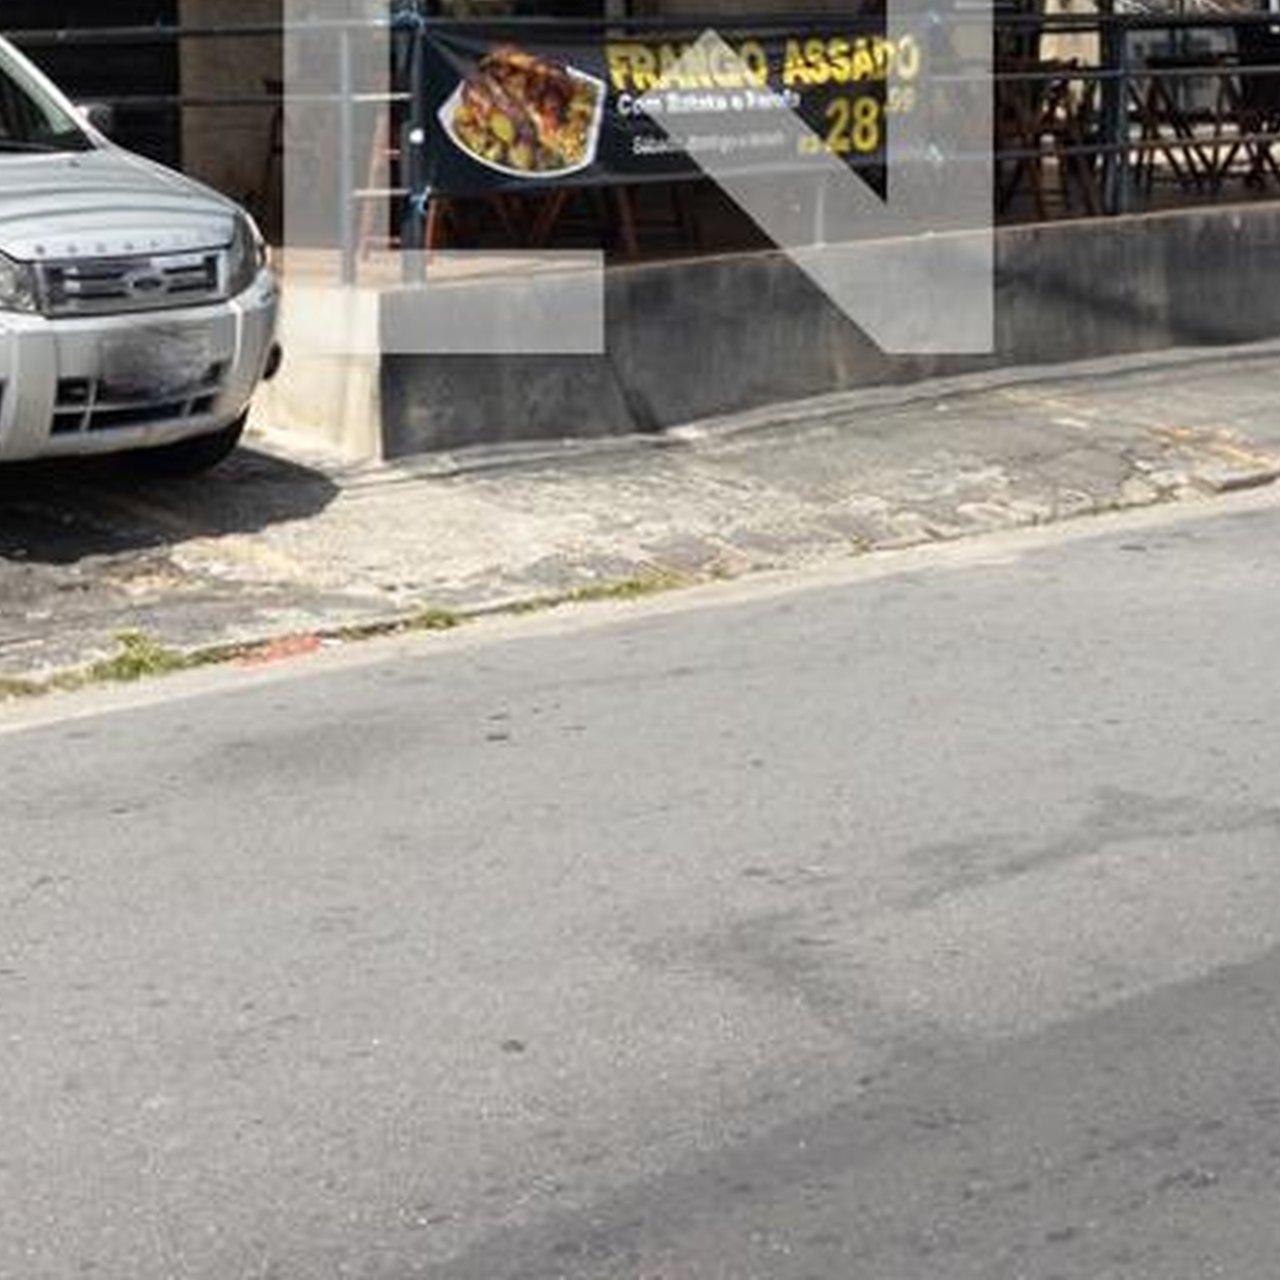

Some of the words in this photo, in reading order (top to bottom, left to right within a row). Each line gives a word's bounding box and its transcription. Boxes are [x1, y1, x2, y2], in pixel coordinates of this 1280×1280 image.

[606, 42, 768, 91] FRANGO
[782, 35, 919, 86] ASSADO
[825, 96, 879, 153] 28
